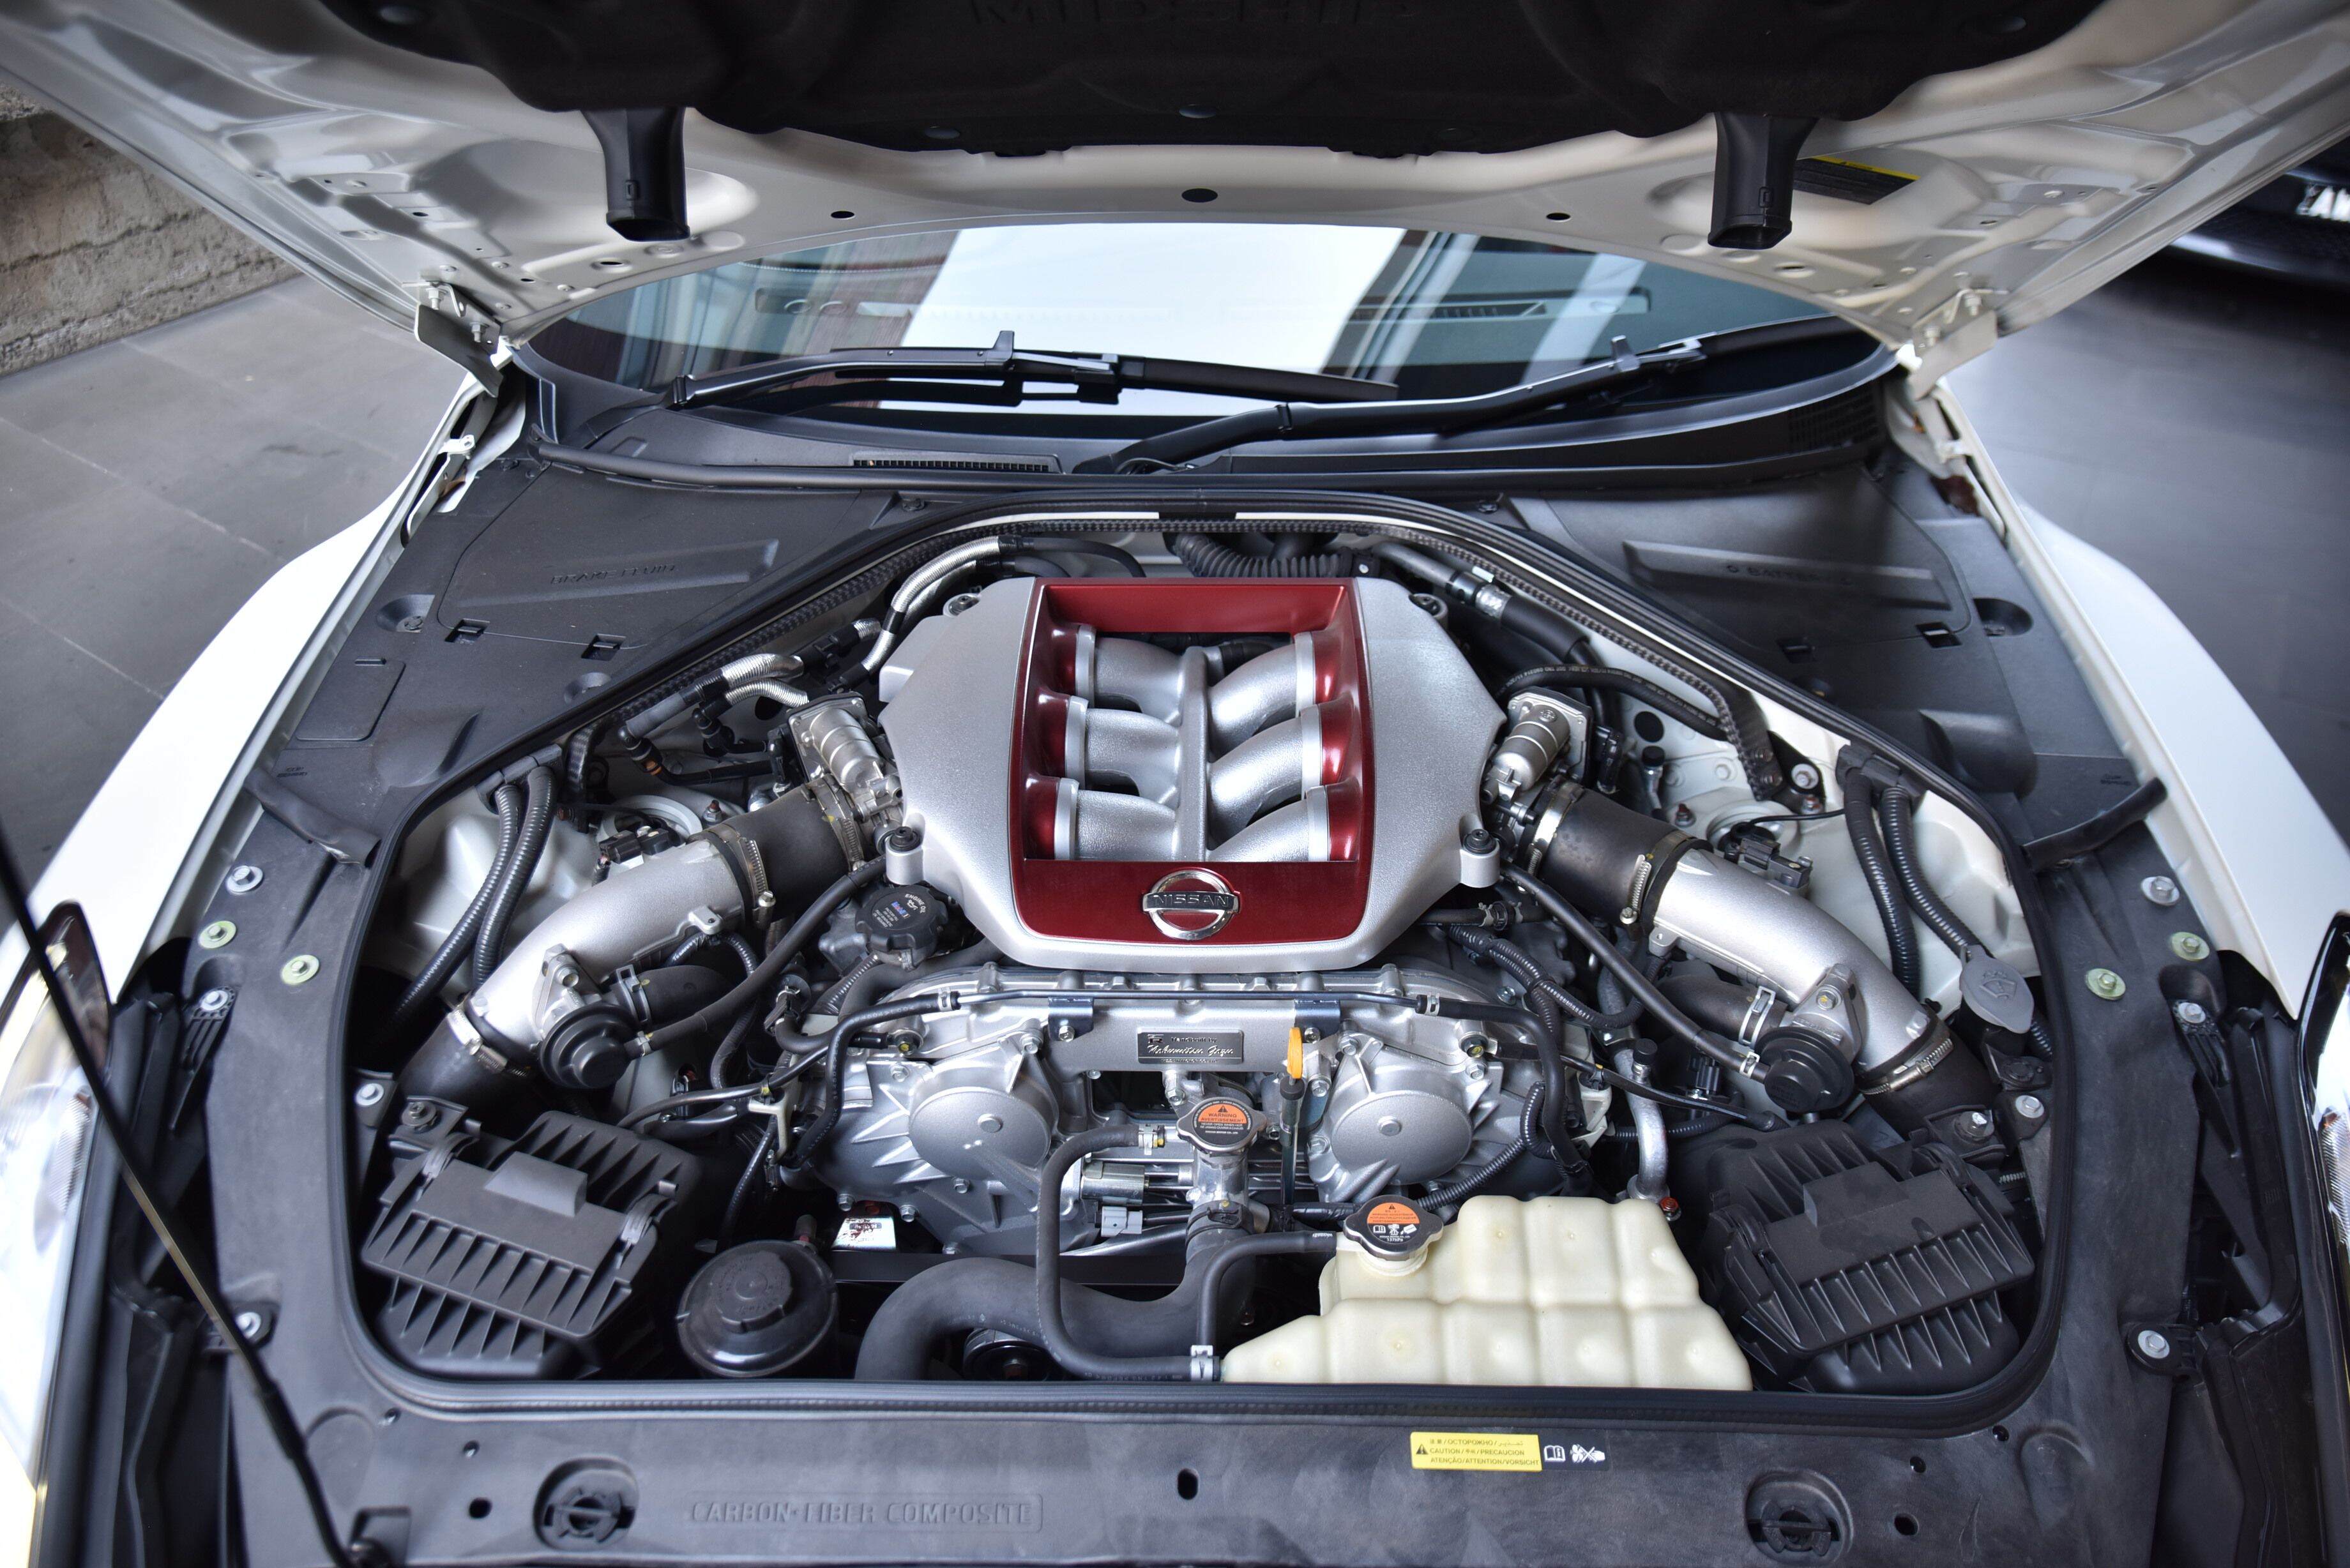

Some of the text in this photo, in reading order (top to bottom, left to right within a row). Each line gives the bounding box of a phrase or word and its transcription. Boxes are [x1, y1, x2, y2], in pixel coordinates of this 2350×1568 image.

[550, 564, 676, 585] BRAKE FLUID
[905, 893, 925, 906] ENGINE
[1153, 894, 1229, 907] NISSAN
[886, 1502, 1034, 1525] COMPOSITE
